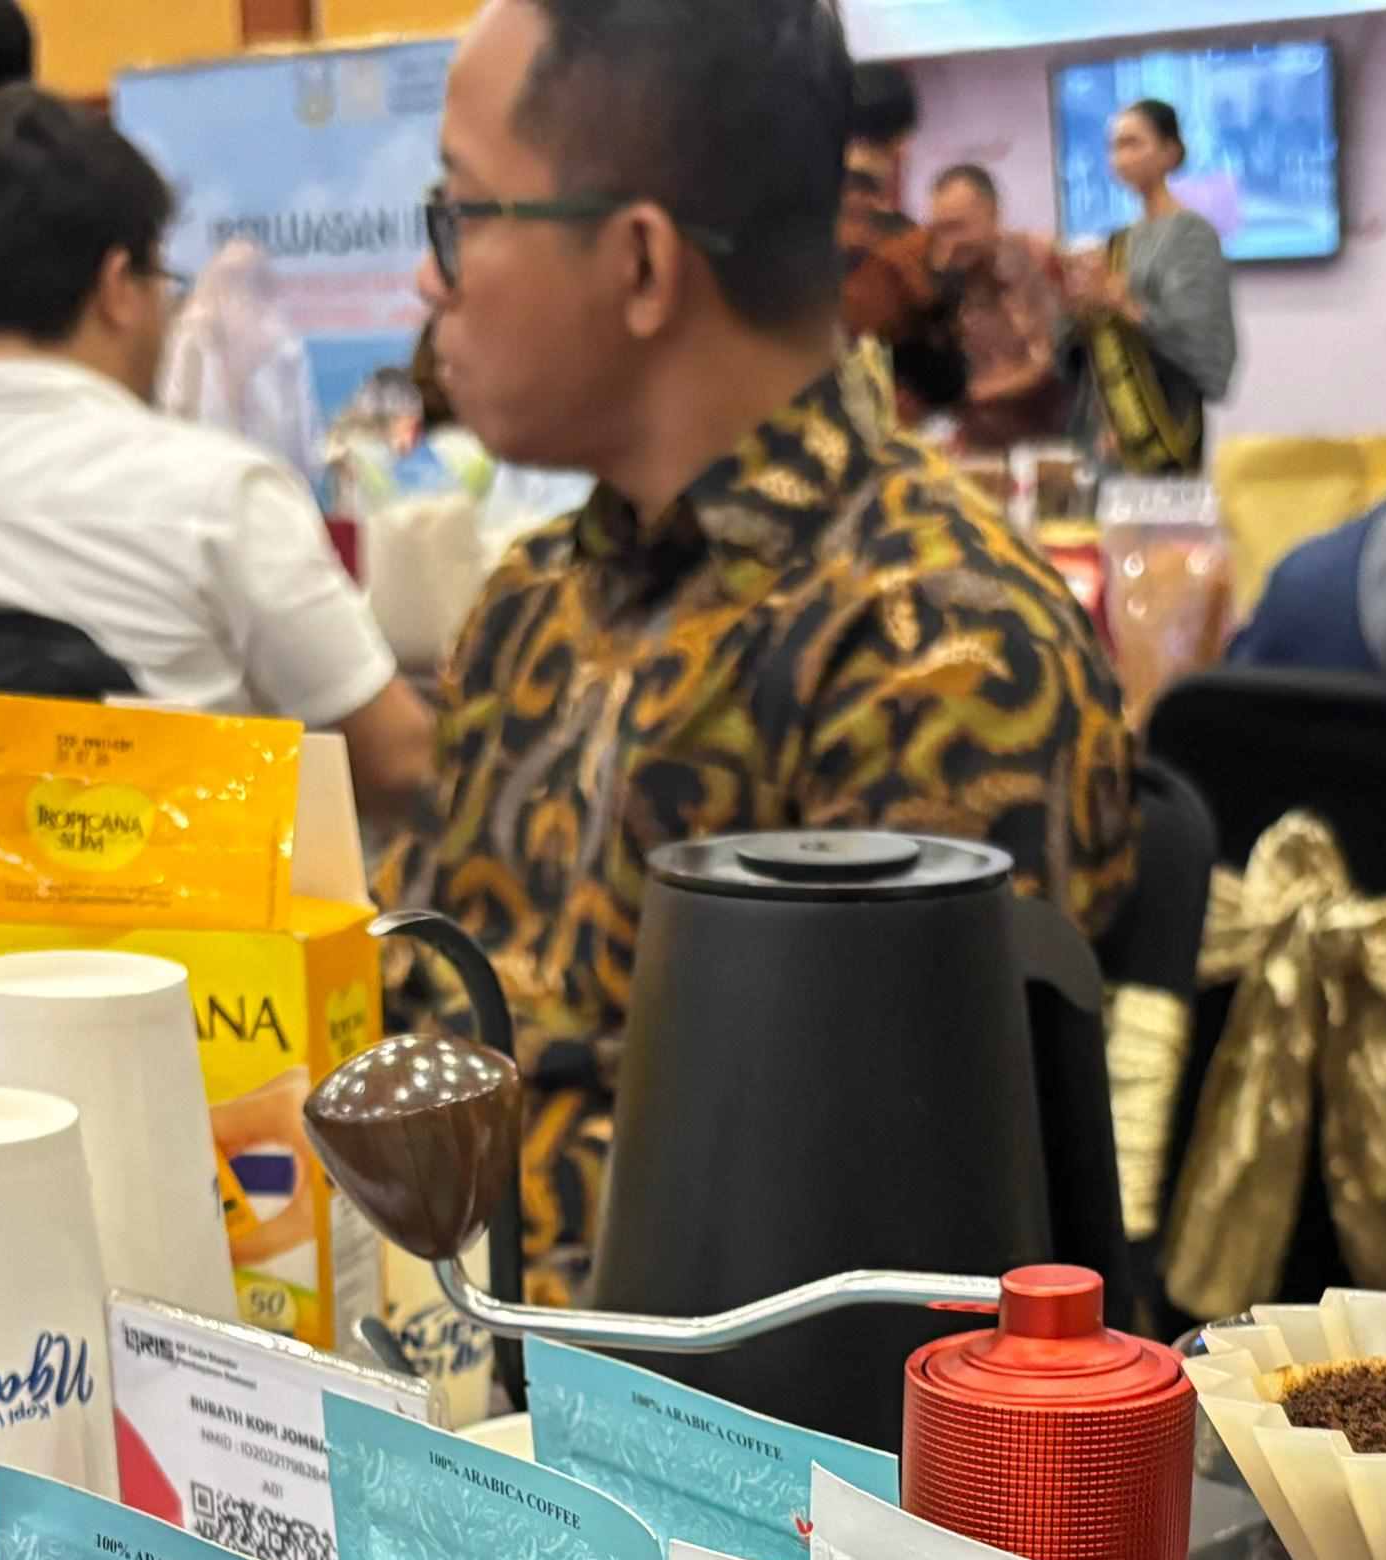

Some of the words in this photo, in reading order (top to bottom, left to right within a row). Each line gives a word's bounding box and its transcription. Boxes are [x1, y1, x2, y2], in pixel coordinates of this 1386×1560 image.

[250, 1287, 286, 1315] 50
[9, 1401, 50, 1424] Kopi
[190, 1395, 243, 1426] RUBATH
[245, 1412, 278, 1438] KOPI
[663, 1403, 725, 1441] ARABICA
[724, 1427, 784, 1462] COFFEE
[428, 1449, 459, 1477] 100%
[461, 1464, 526, 1504] ARABICA
[525, 1489, 582, 1532] COFFEE
[94, 1532, 133, 1560] 100%
